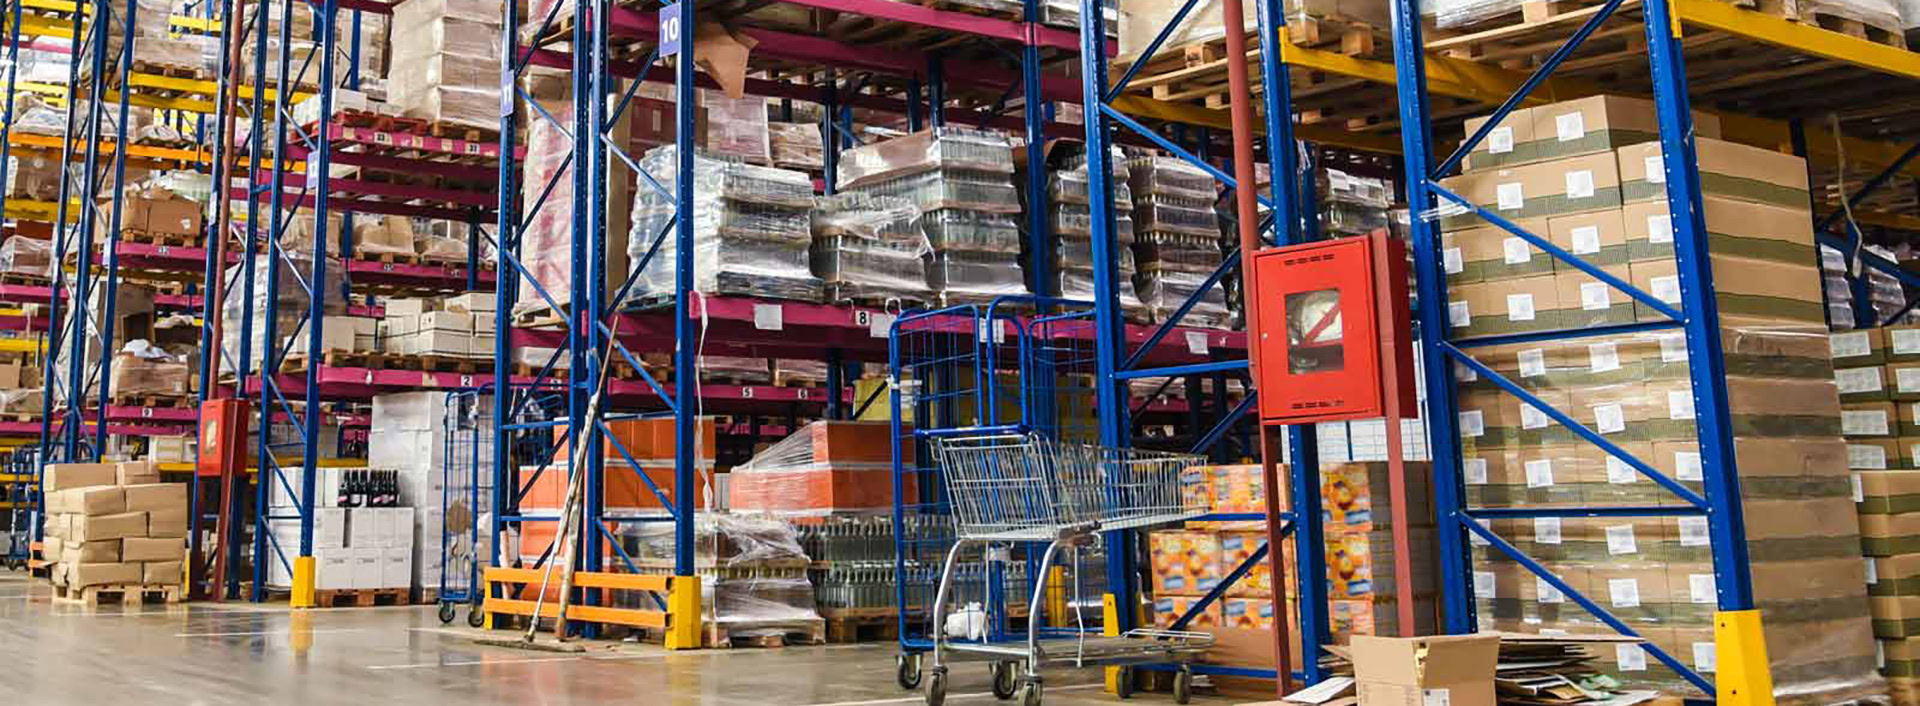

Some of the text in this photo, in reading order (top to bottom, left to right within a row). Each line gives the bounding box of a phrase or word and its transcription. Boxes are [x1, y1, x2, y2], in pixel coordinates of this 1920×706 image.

[662, 17, 678, 42] 10
[503, 84, 512, 105] 11
[859, 311, 867, 324] 8
[464, 376, 470, 386] 2
[744, 388, 750, 397] 5
